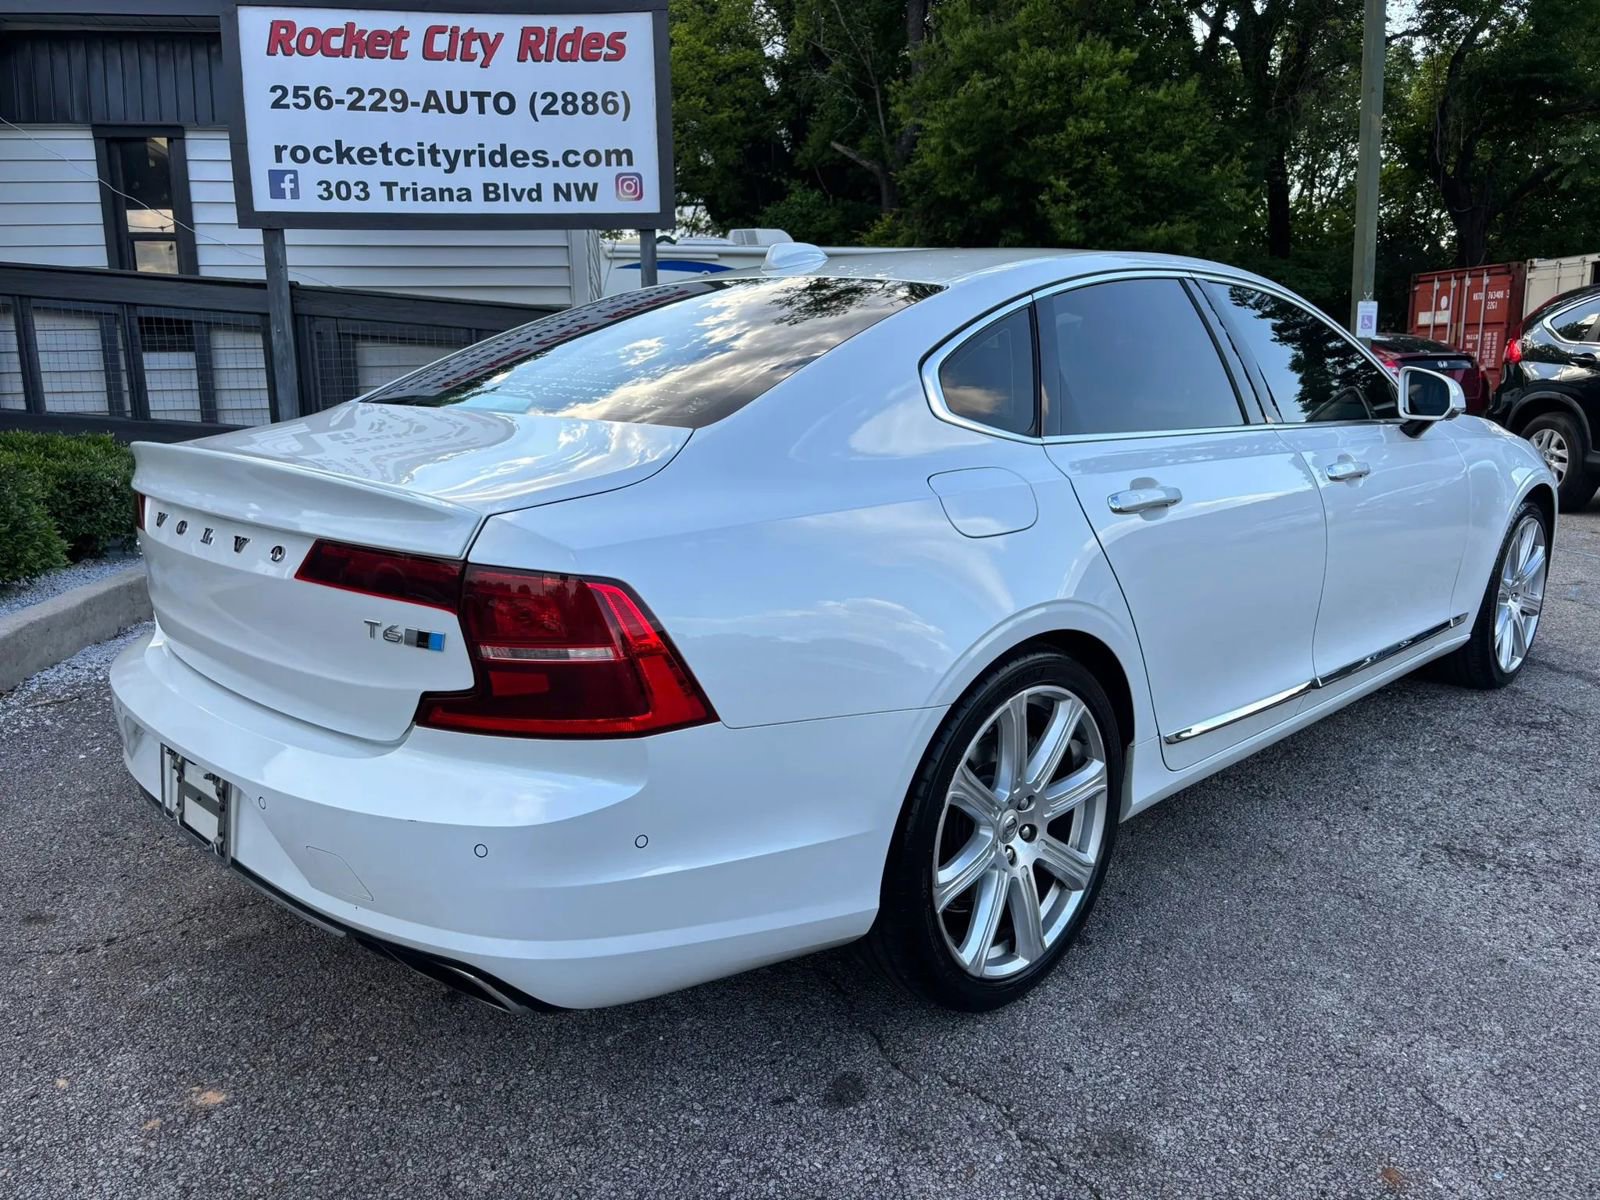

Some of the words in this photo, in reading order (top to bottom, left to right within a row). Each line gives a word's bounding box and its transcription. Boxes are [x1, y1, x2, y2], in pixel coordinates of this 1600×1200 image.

[267, 20, 410, 61] Rocket
[422, 25, 505, 68] City
[517, 26, 627, 63] Rides
[270, 85, 517, 116] 256-229-AUTO
[529, 90, 631, 122] (2886)
[274, 140, 634, 174] rocketcityrides.com
[317, 181, 370, 202] 303
[380, 182, 473, 203] Triana
[483, 183, 542, 203] Blvd
[553, 183, 599, 202] NW
[155, 511, 287, 562] VOLVO
[363, 619, 404, 643] T6
